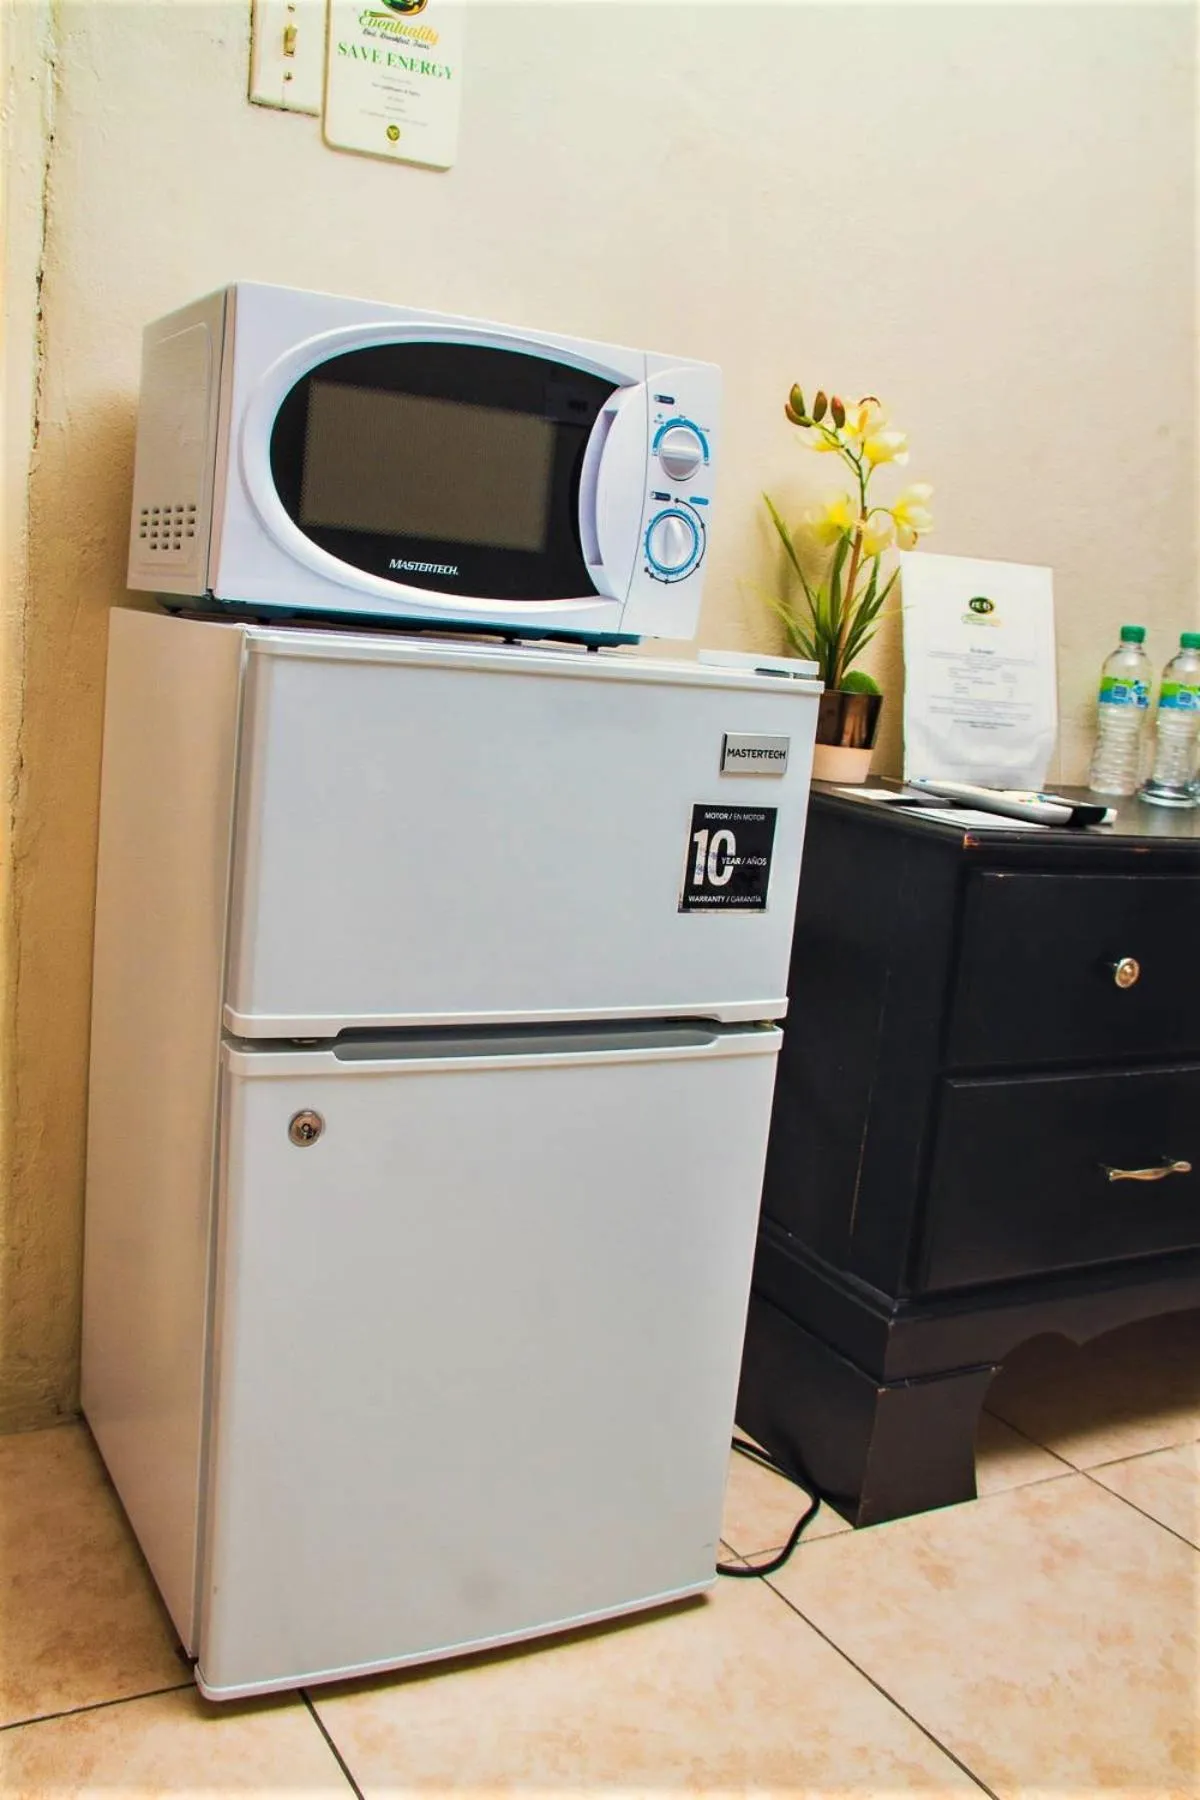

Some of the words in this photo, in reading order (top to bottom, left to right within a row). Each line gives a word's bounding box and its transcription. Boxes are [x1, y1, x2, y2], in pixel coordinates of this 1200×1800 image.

[337, 42, 382, 64] SAVE
[387, 51, 453, 80] ENERGY
[726, 748, 787, 760] MASTERTECH
[704, 812, 729, 820] MOTOR
[743, 813, 765, 821] MOTOR
[693, 829, 736, 886] 10
[721, 856, 742, 865] YEAR
[688, 895, 725, 903] WARRANTY
